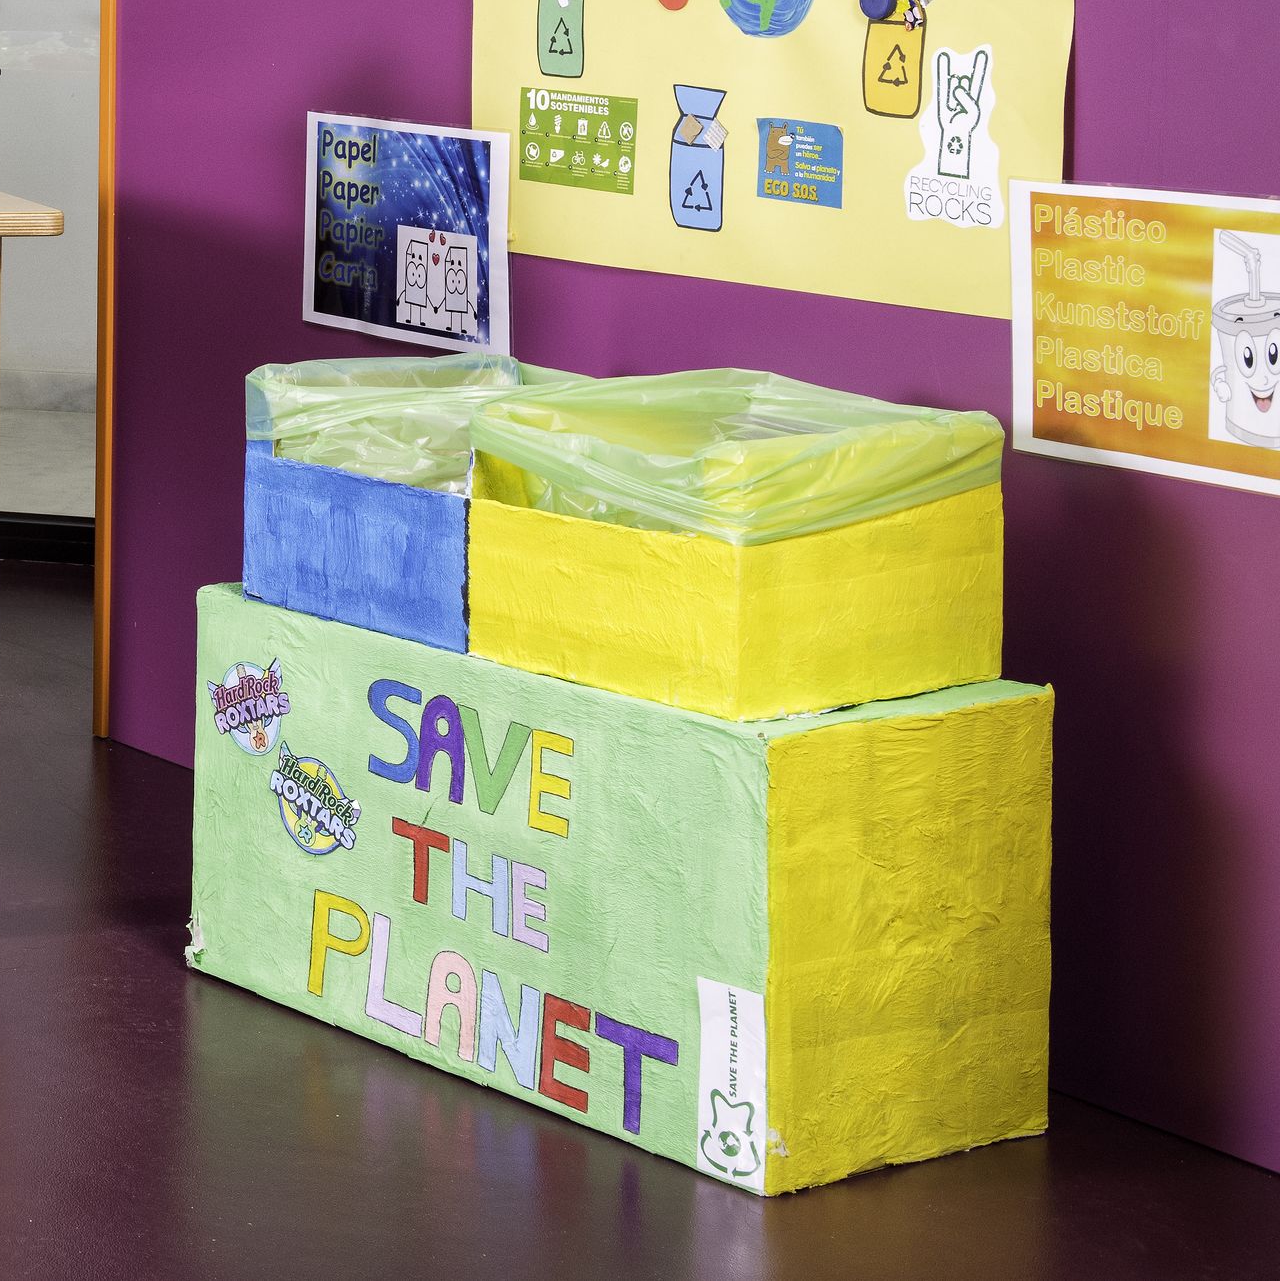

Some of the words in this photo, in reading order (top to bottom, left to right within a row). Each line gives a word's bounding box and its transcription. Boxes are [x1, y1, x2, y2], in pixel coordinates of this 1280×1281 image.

[527, 89, 550, 110] 10
[550, 93, 609, 105] MANDAMIENTOS
[550, 102, 609, 115] SOSTENIBLES
[321, 129, 377, 169] Papel
[320, 170, 379, 210] Paper
[764, 178, 789, 196] ECO
[792, 183, 818, 201] S.O.S.
[909, 191, 992, 225] ROCKS
[910, 175, 992, 201] RECYCLING
[319, 211, 384, 251] Papier
[1034, 203, 1167, 244] Plástico
[318, 254, 378, 289] Carta
[1034, 248, 1145, 287] Plastic
[1035, 291, 1205, 340] Kunststoff
[1035, 335, 1163, 382] Plastica
[1036, 379, 1184, 430] Plastique
[213, 678, 245, 710] Hard
[244, 671, 279, 700] Rock
[214, 693, 291, 734] ROXTARS
[367, 678, 574, 838] SAVE
[270, 770, 357, 850] ROXTARS
[282, 755, 322, 795] Hard
[316, 780, 355, 827] Rock
[391, 816, 549, 953] THE
[306, 889, 679, 1134] PLANET
[728, 991, 738, 1038] PLANET
[729, 1040, 738, 1064] THE
[728, 1067, 737, 1098] SAVE
